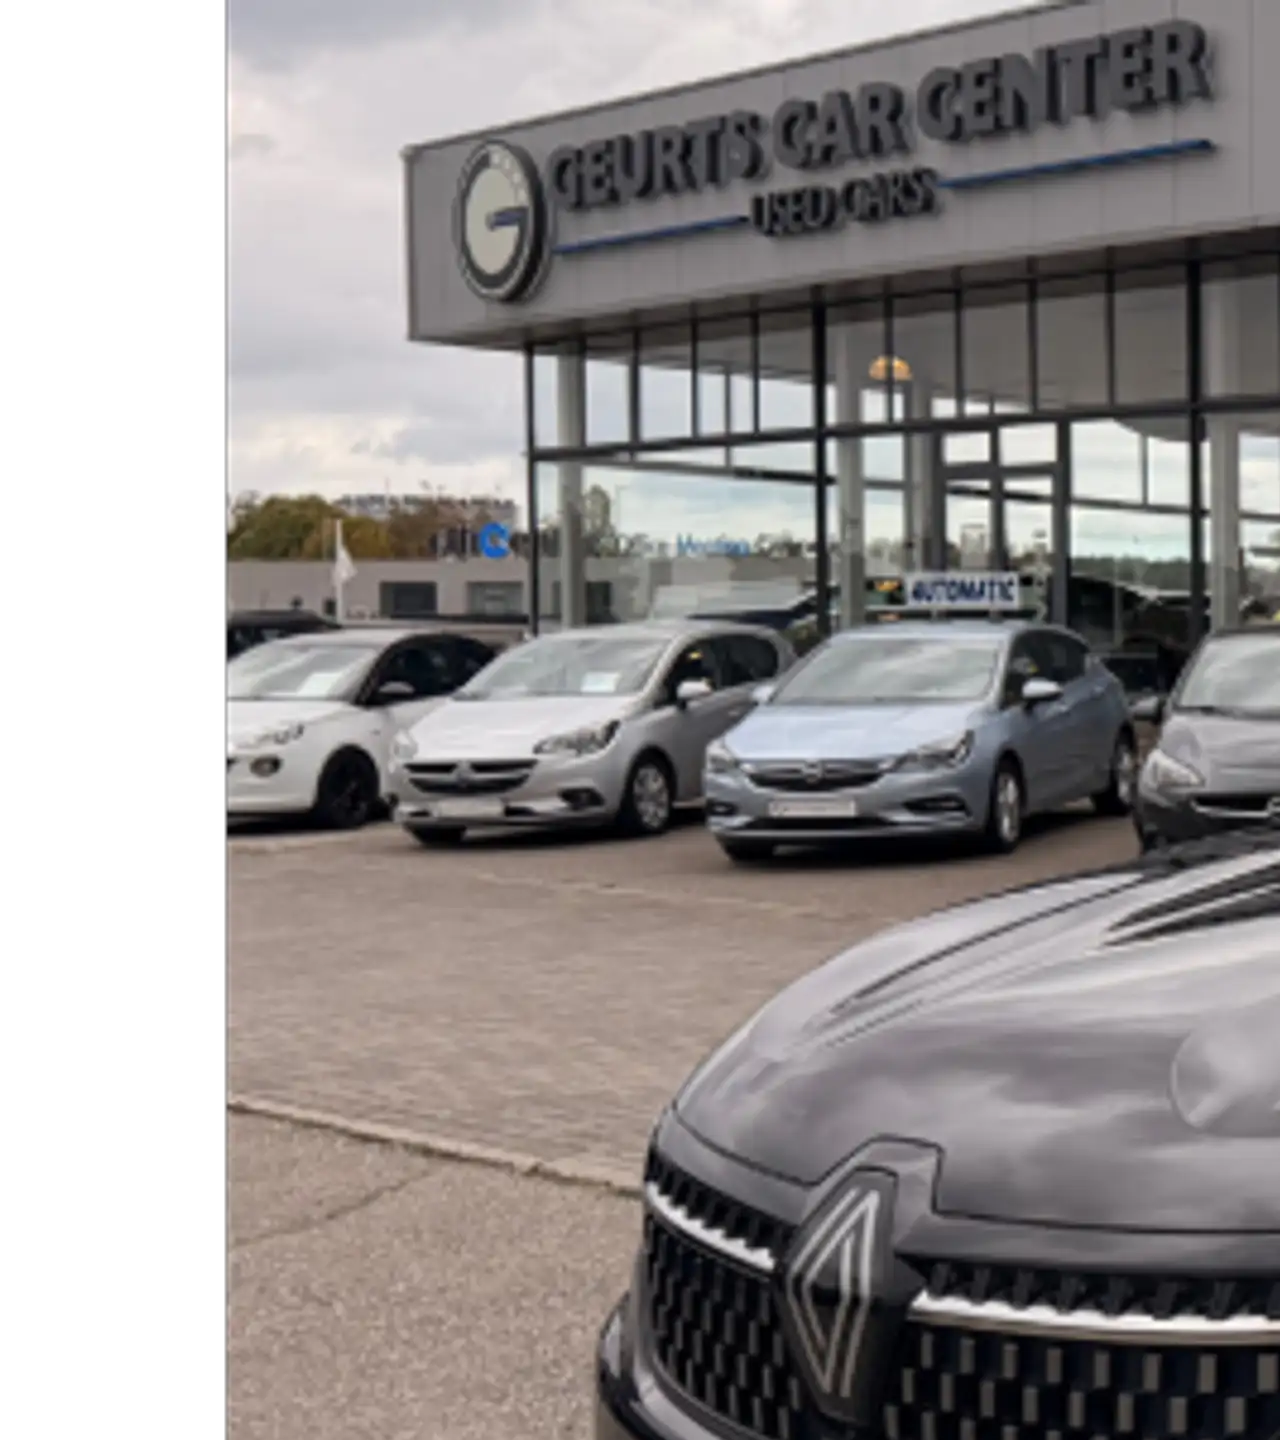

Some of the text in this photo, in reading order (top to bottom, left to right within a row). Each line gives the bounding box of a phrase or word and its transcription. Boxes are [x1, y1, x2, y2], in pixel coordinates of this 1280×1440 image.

[546, 19, 1212, 210] GEURTS CAR CENTER
[750, 167, 941, 237] USED CARS
[911, 576, 1015, 603] AUTOMATIC
